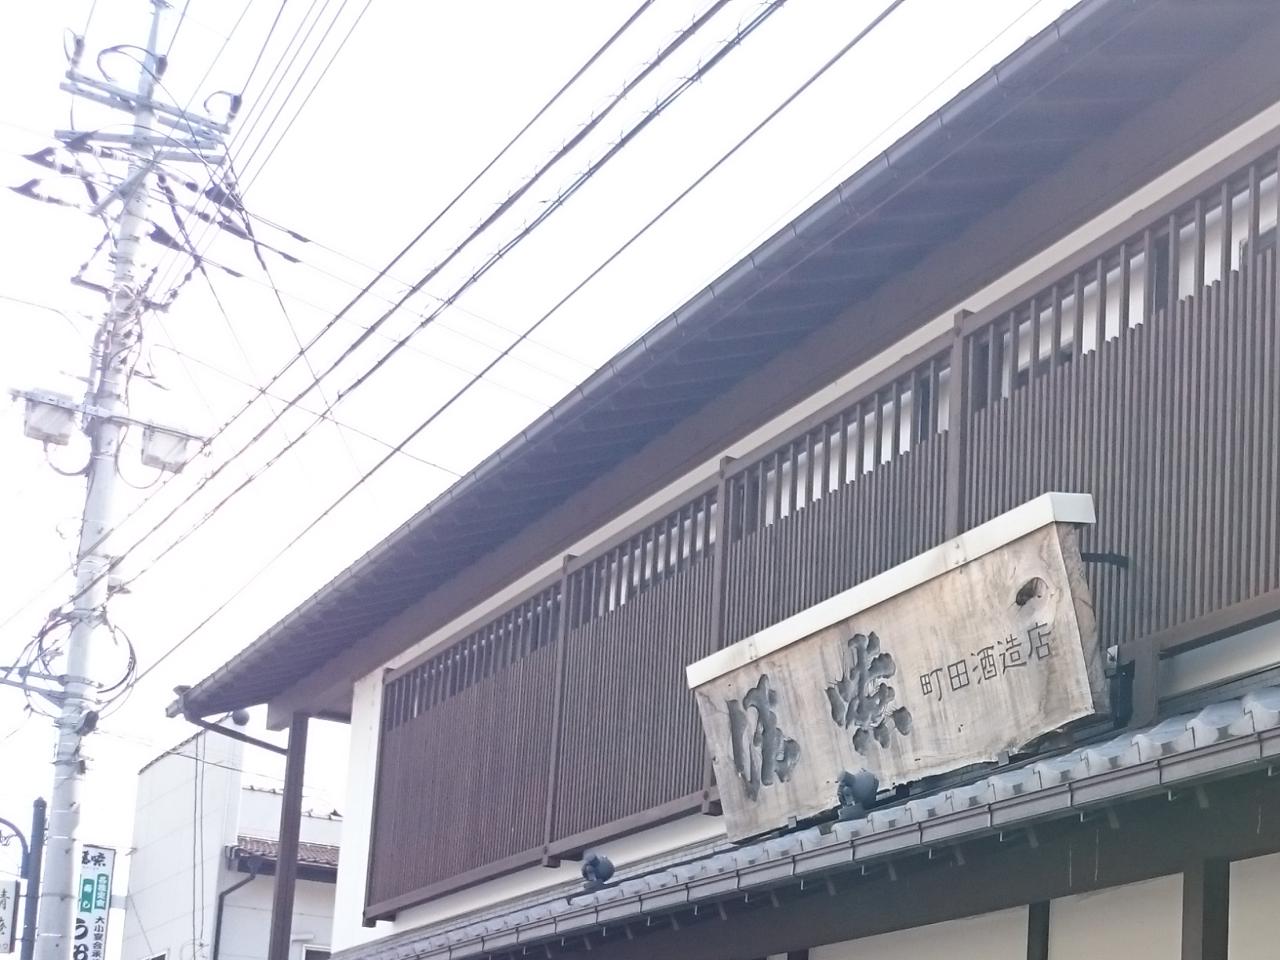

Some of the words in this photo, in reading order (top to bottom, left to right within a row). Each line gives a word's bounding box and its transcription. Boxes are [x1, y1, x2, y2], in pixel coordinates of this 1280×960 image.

[919, 622, 1055, 702] 町田酒造店
